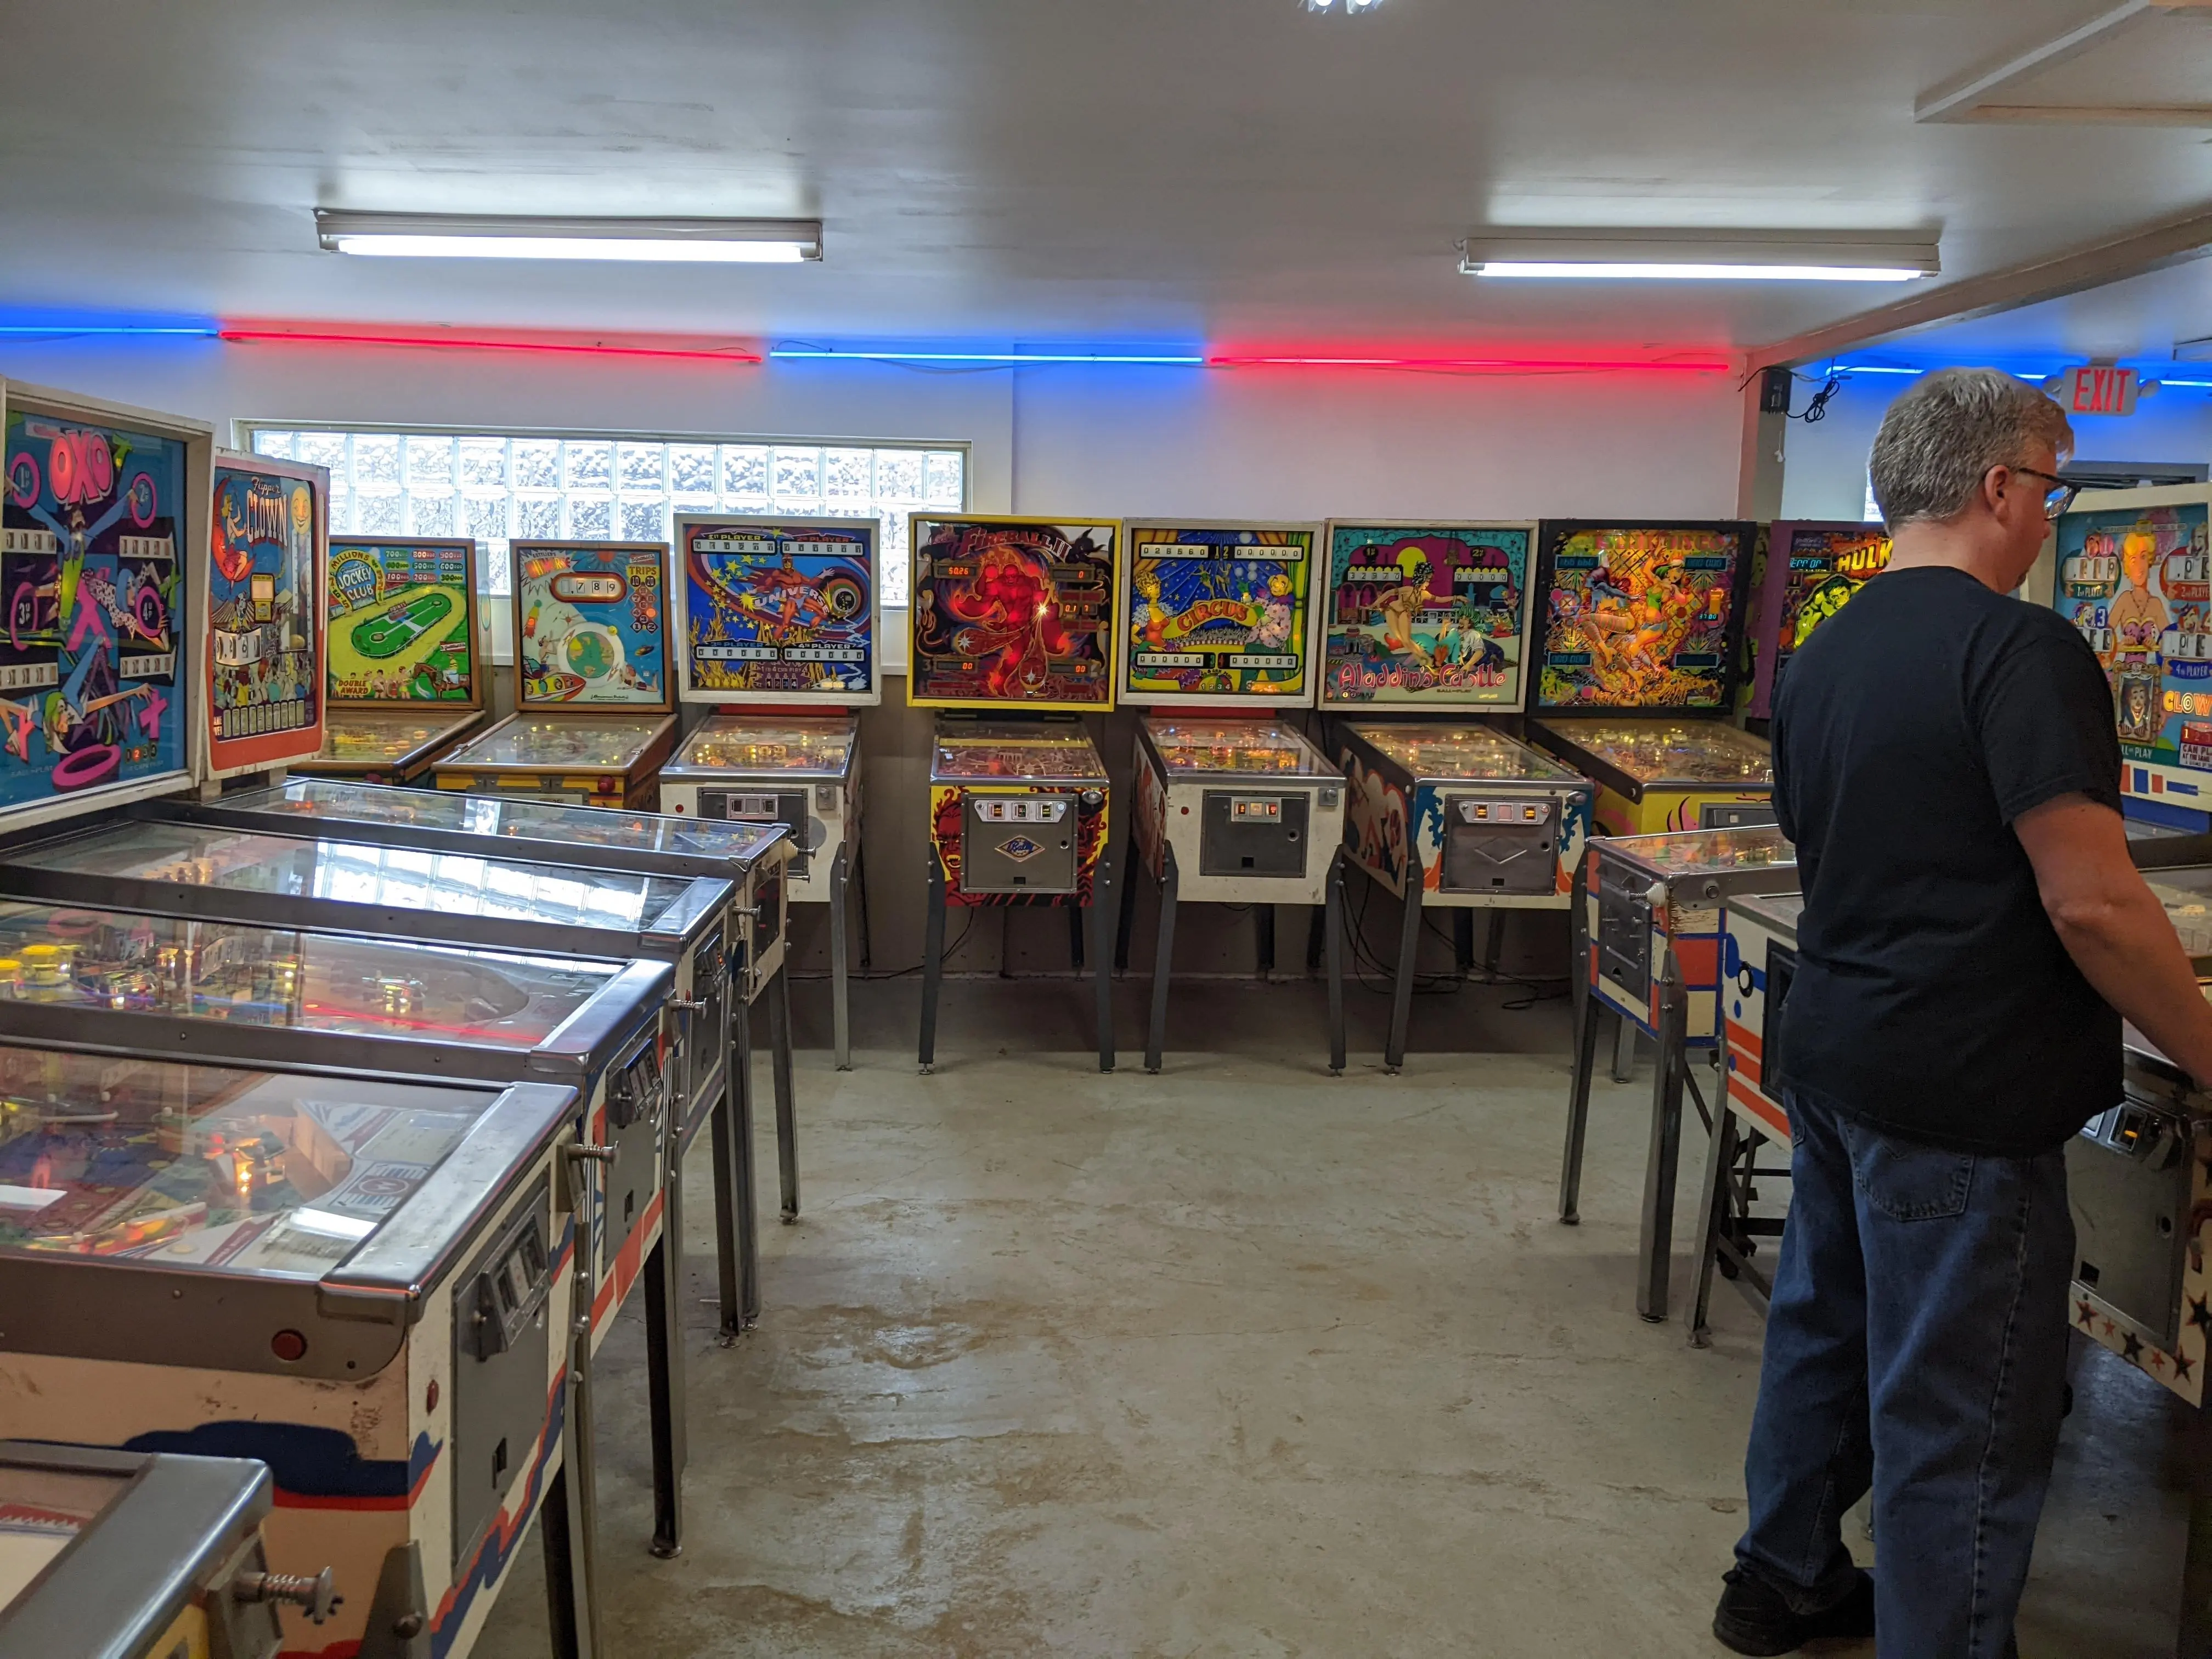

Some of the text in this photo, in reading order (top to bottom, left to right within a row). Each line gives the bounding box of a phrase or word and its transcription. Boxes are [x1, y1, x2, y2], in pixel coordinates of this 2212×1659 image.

[2073, 368, 2131, 411] EXIT
[50, 428, 113, 504] OXO
[251, 476, 281, 495] Flipper
[247, 489, 287, 547] CLOWN
[959, 527, 1072, 562] FIREBALL II
[1837, 539, 1893, 572] HULK
[338, 567, 372, 590] JOCKEY
[629, 566, 657, 575] TRIPS
[632, 577, 654, 585] 10 20
[347, 583, 374, 601] CLUB
[754, 586, 830, 615] UNIVERSE
[1177, 601, 1249, 631] CIRCUS
[2097, 608, 2106, 627] 3
[1338, 662, 1506, 688] Aladdin's Castle
[2186, 664, 2208, 676] PLAYER
[2135, 748, 2153, 759] PLAY
[2183, 744, 2198, 753] CAN
